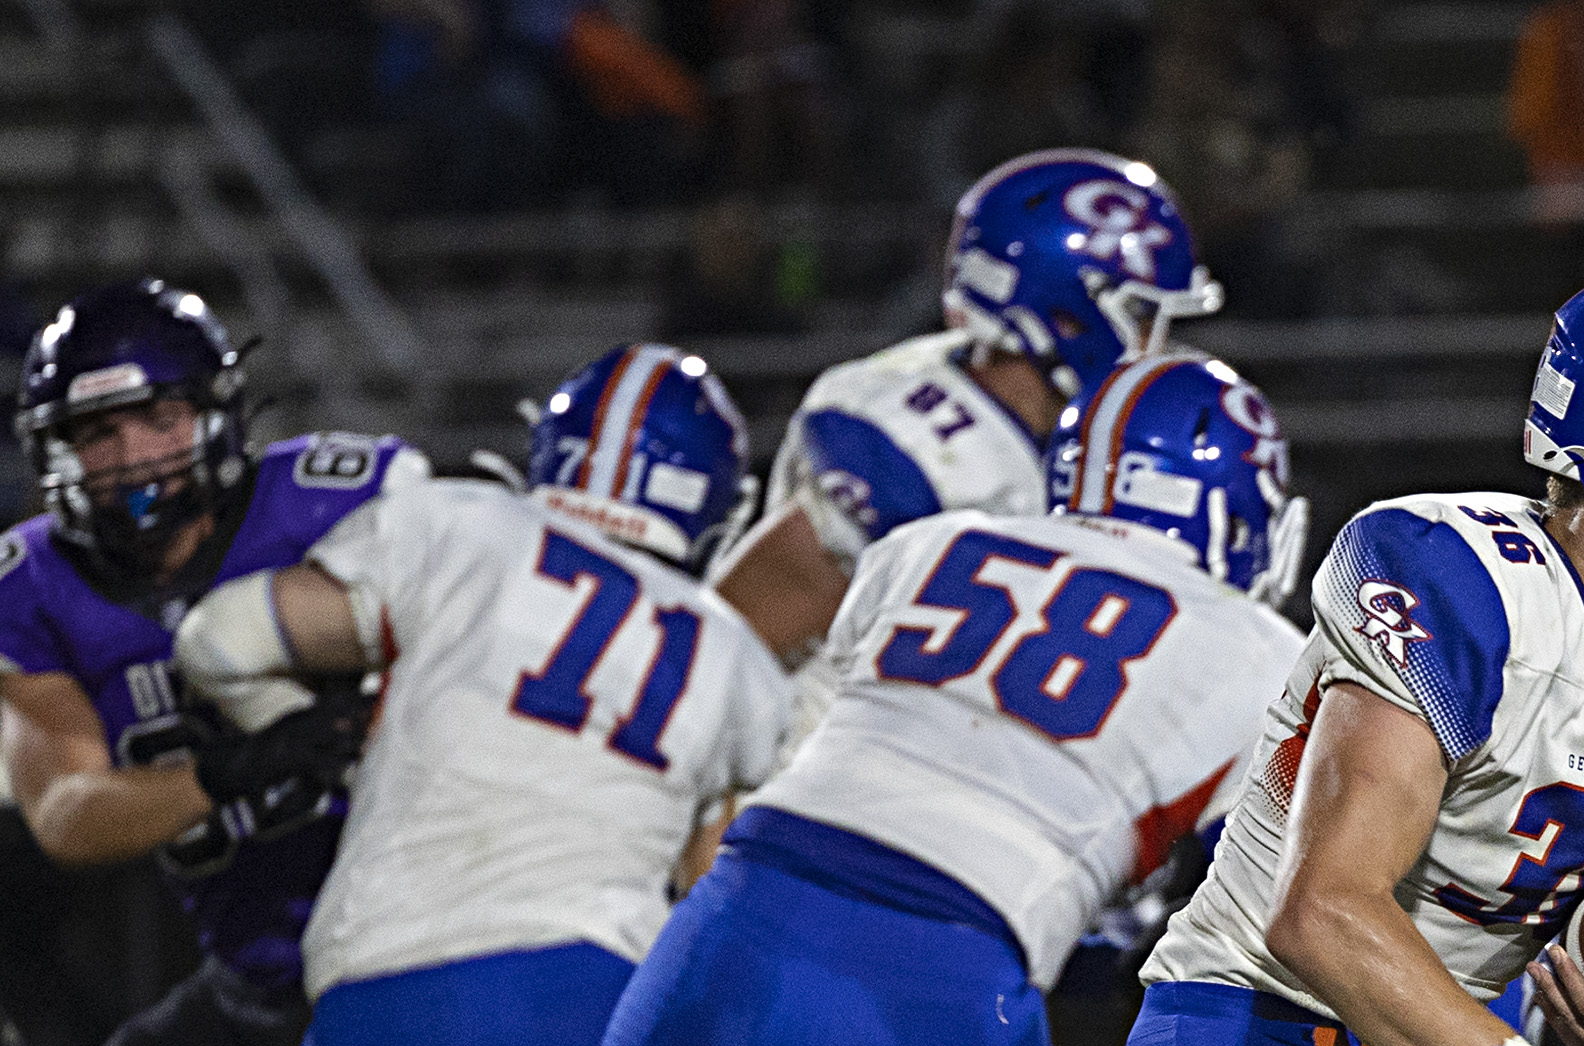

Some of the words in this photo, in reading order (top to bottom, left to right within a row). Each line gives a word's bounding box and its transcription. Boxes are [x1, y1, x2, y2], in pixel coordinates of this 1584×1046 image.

[1457, 504, 1547, 566] 36
[509, 524, 702, 773] 71
[875, 528, 1178, 744] 58
[1352, 578, 1433, 669] GK
